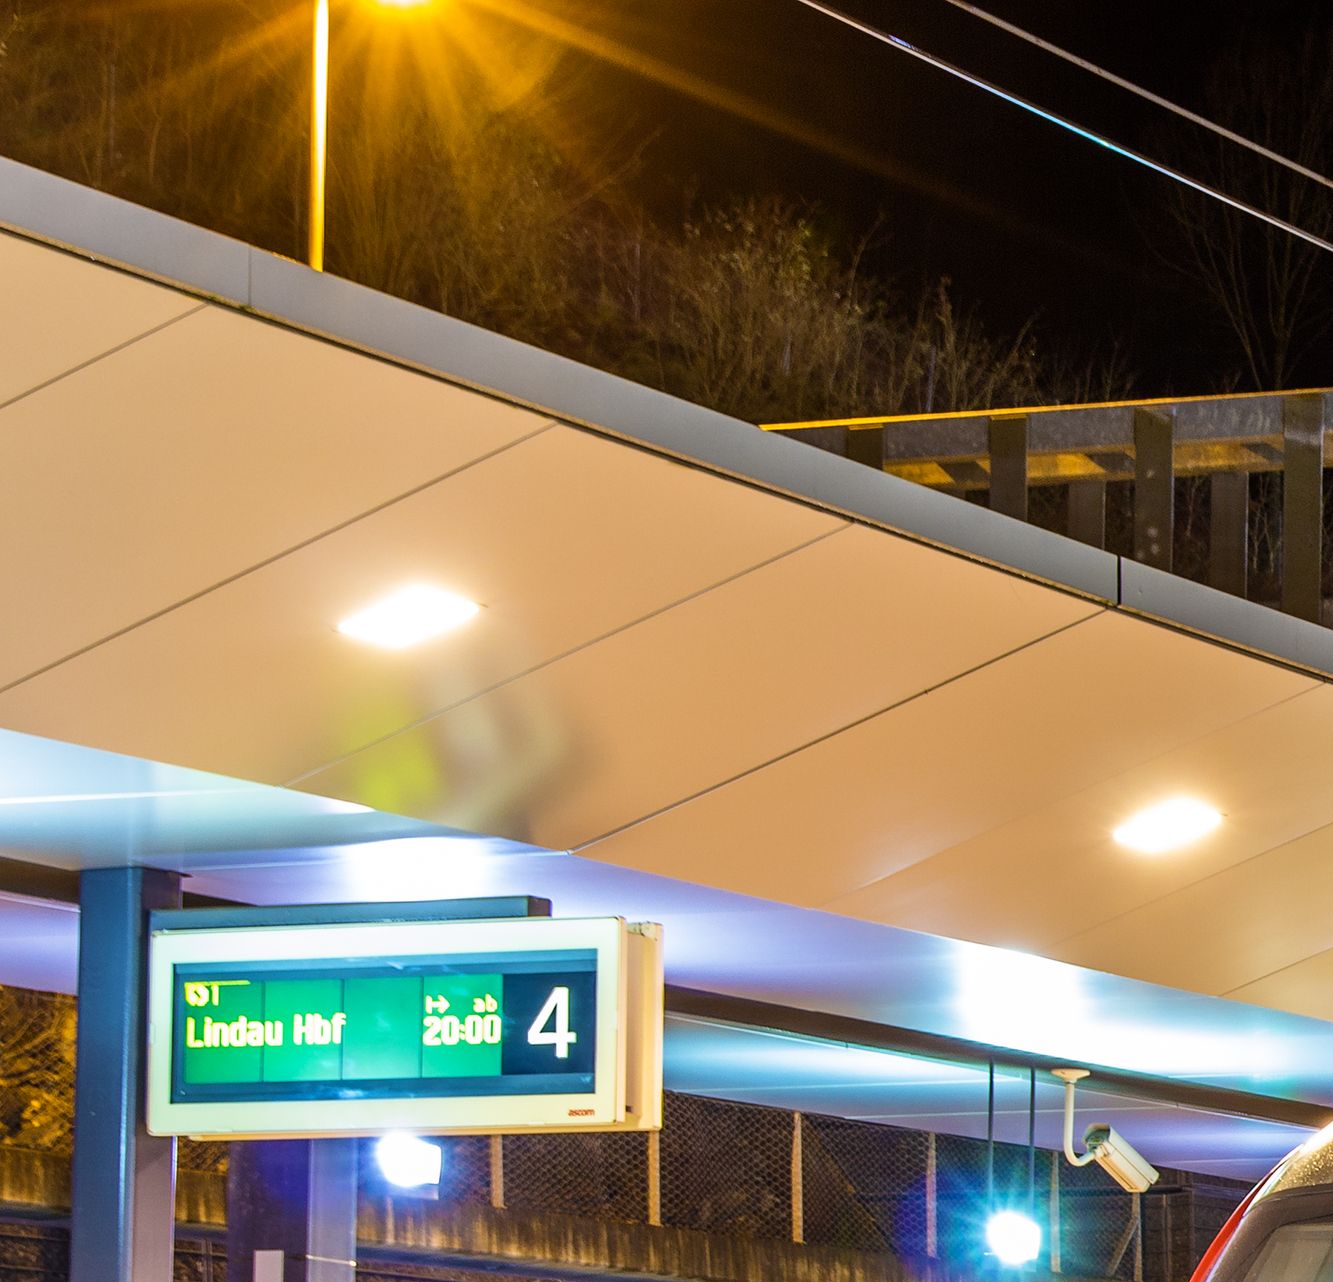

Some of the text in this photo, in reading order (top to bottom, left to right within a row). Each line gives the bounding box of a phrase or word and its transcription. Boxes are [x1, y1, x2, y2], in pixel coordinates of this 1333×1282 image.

[473, 994, 498, 1012] ab
[187, 1012, 346, 1048] Lindau Hbf
[422, 1014, 501, 1046] 20:00
[527, 986, 577, 1058] 4
